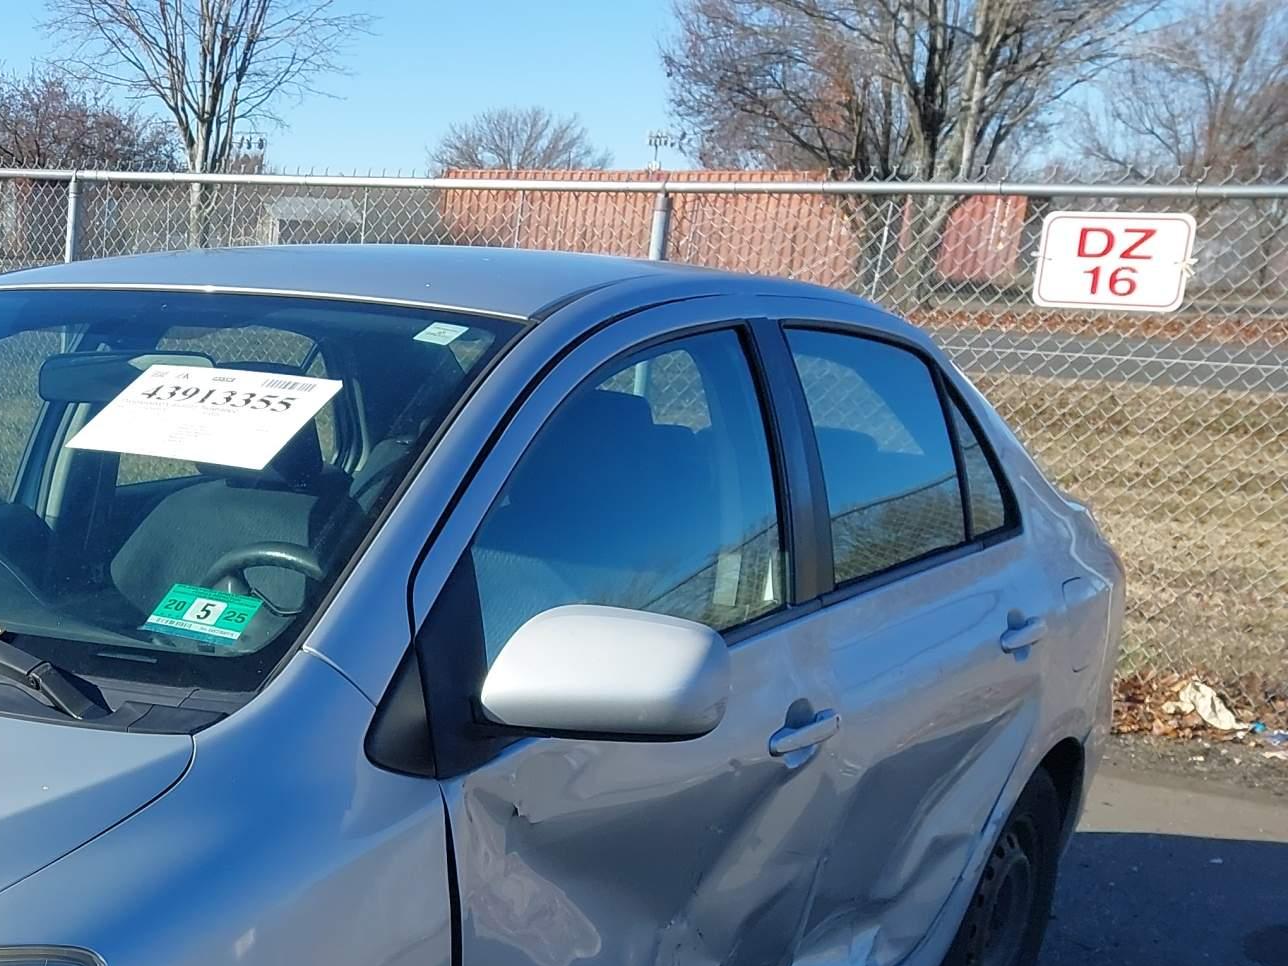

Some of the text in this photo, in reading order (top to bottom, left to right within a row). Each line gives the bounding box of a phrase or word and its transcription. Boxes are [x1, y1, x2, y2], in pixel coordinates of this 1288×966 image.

[1077, 227, 1158, 259] DZ
[1083, 266, 1138, 297] 16
[141, 384, 299, 412] 43913355
[164, 598, 249, 624] 20 5 25
